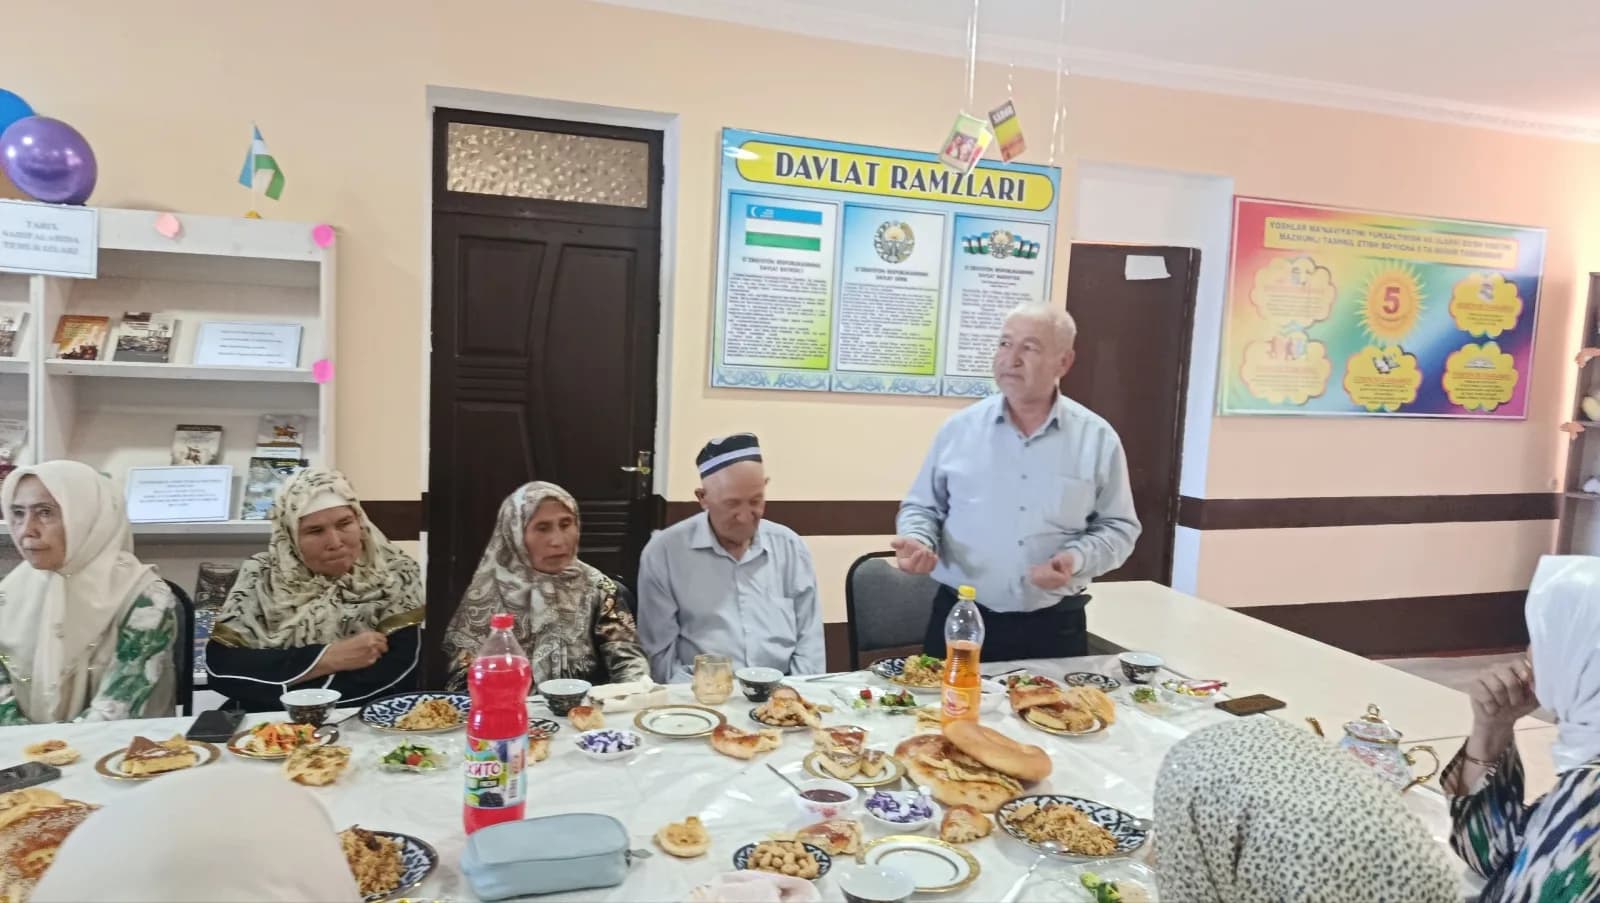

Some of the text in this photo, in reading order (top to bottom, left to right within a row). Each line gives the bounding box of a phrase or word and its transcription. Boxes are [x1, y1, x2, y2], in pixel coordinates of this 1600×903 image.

[776, 152, 1026, 202] DAVLAT RAMZLARI
[1382, 287, 1401, 314] 5
